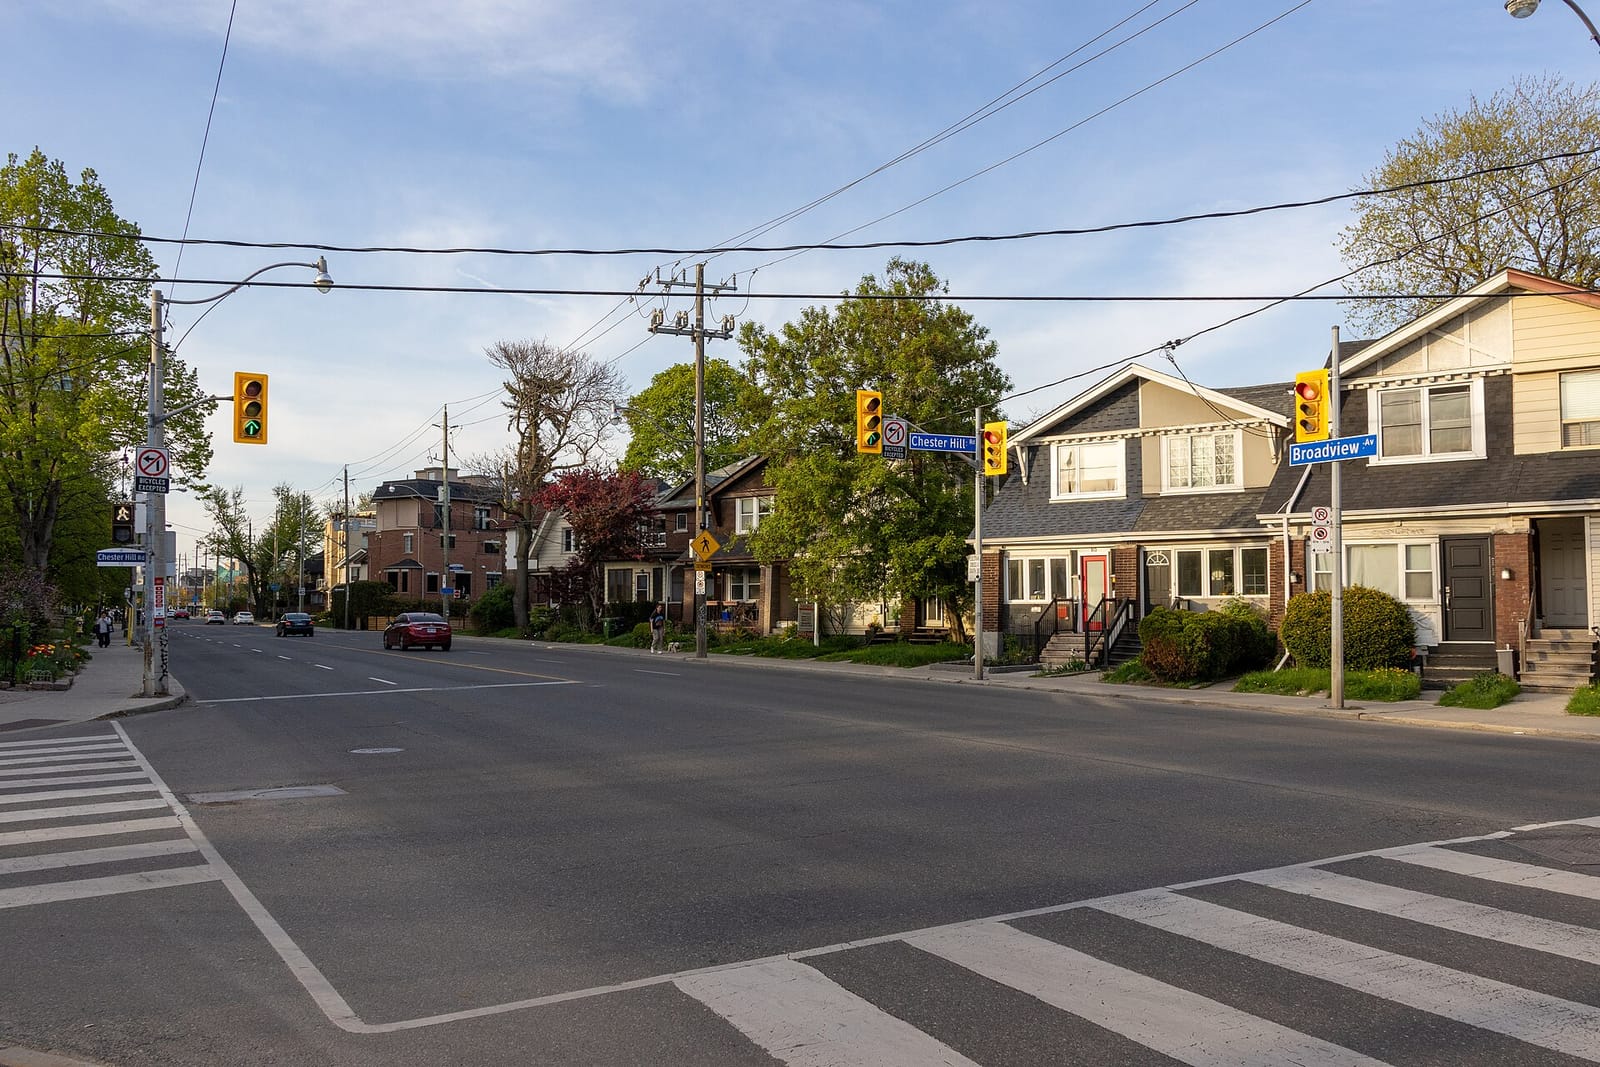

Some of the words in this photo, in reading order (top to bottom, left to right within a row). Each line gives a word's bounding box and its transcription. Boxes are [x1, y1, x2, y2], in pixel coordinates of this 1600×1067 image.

[911, 435, 947, 448] Chester
[950, 438, 966, 449] Hill
[1293, 442, 1359, 461] Broadview
[1364, 438, 1374, 447] Av
